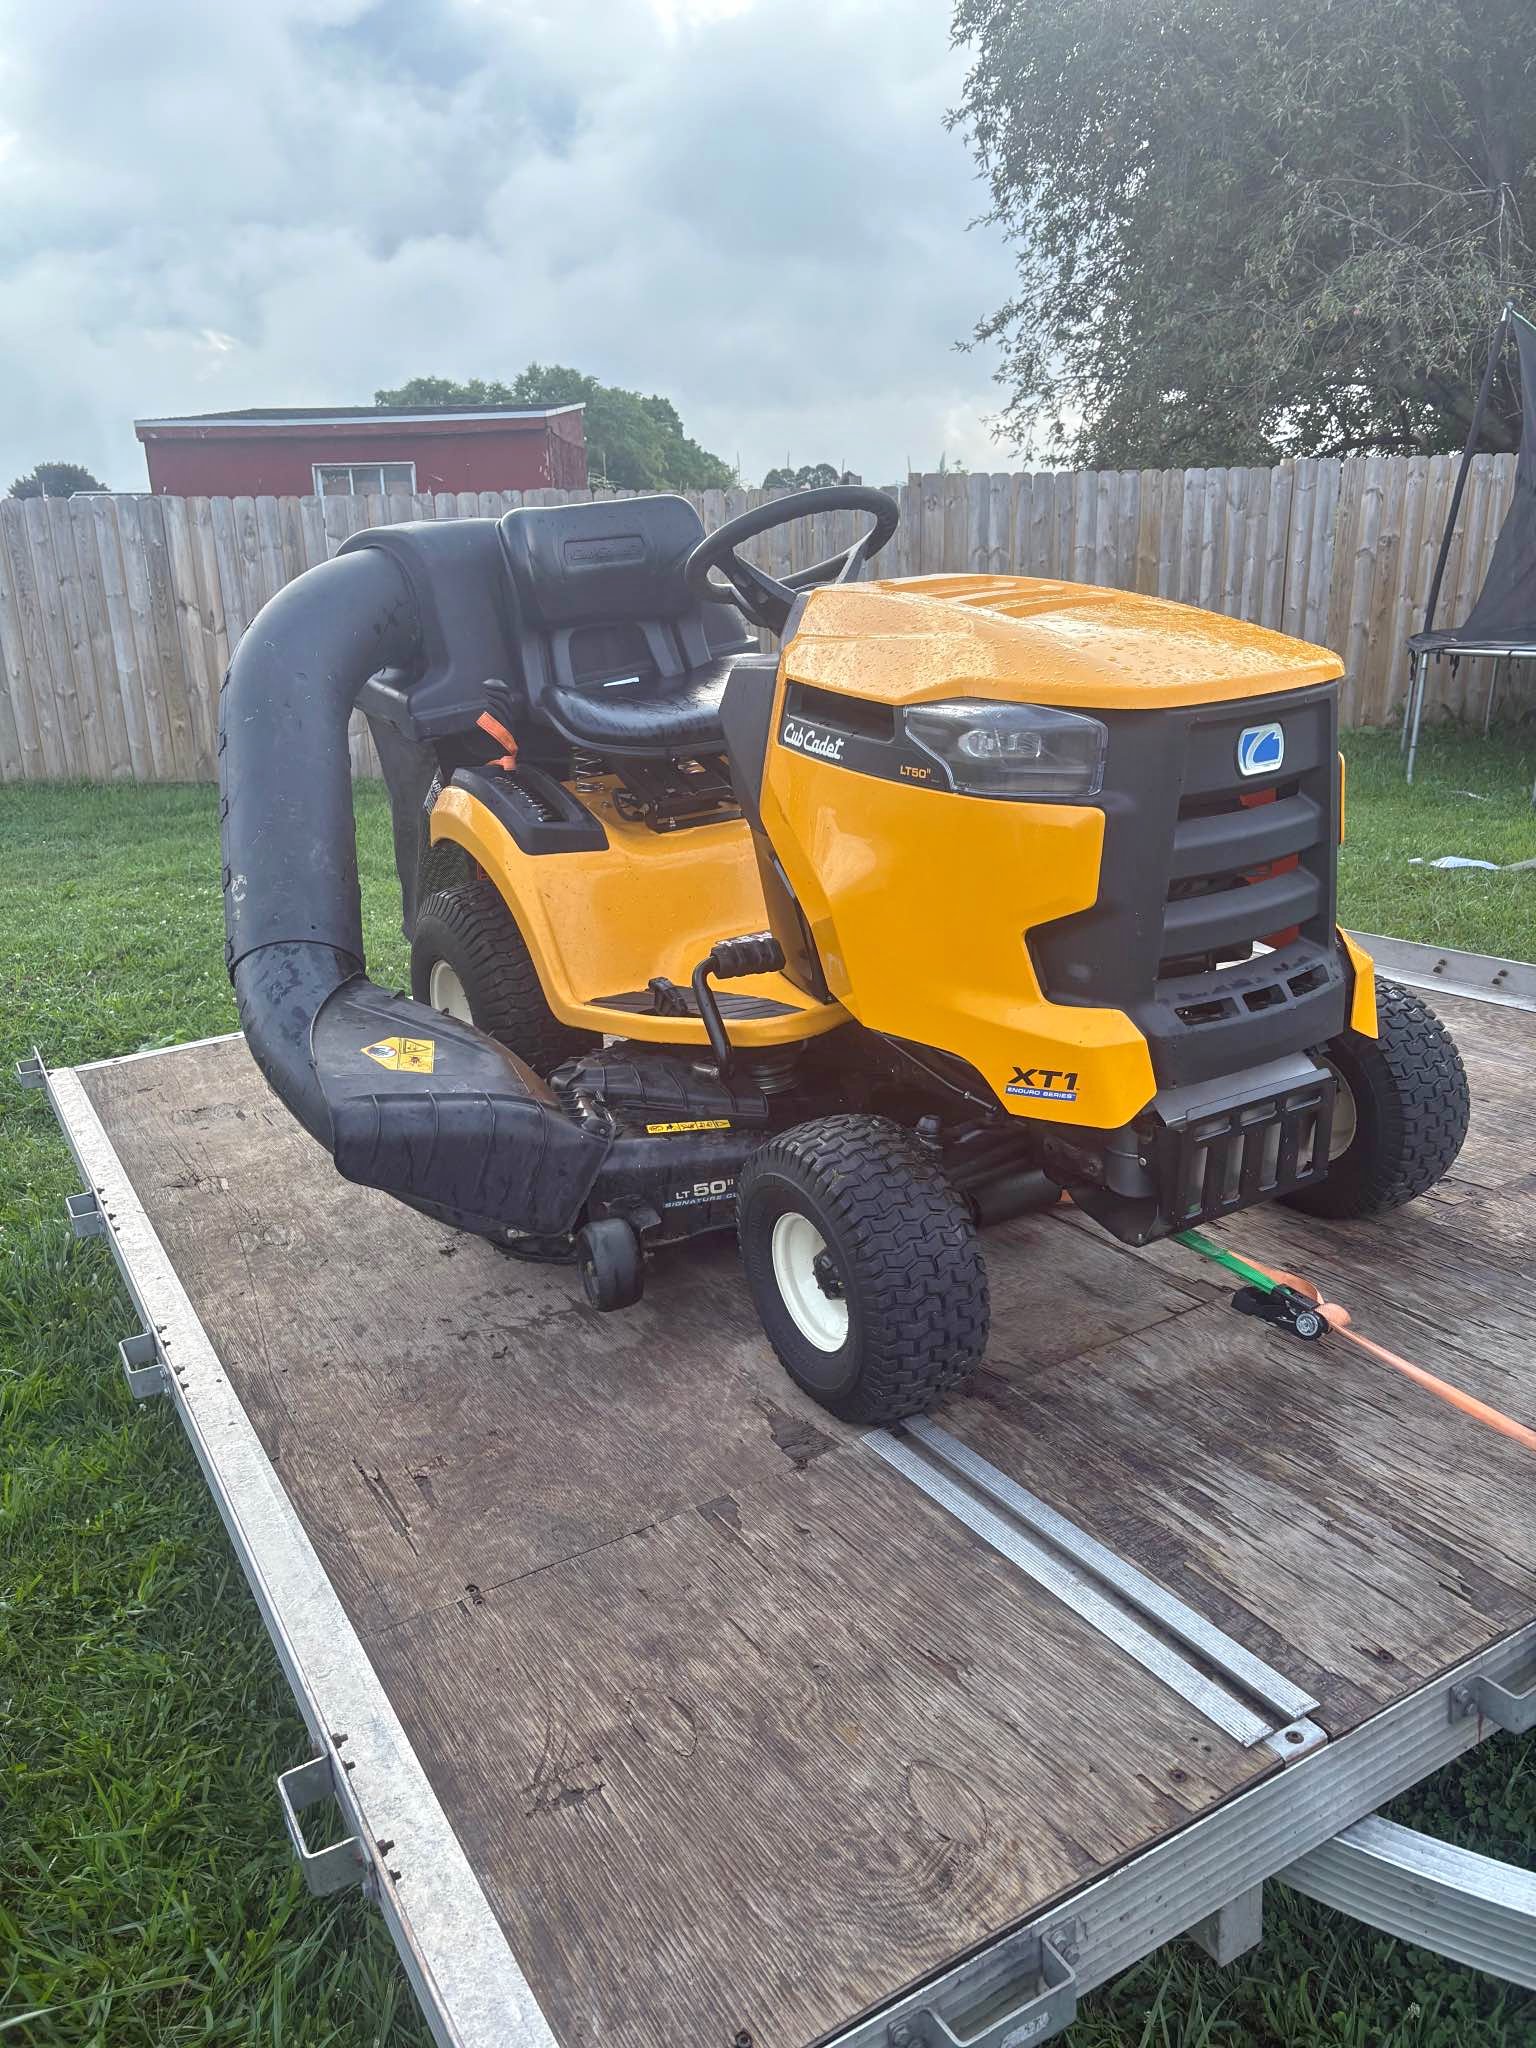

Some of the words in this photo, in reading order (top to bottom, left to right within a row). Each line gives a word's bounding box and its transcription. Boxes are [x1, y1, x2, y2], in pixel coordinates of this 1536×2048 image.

[784, 723, 804, 747] Cub
[804, 730, 844, 759] Cadet
[1007, 1066, 1078, 1091] XT1
[1007, 1087, 1041, 1096] ENDURO
[1042, 1091, 1073, 1099] SERIES
[675, 1190, 690, 1199] LT
[664, 1195, 722, 1208] SIGNATURE
